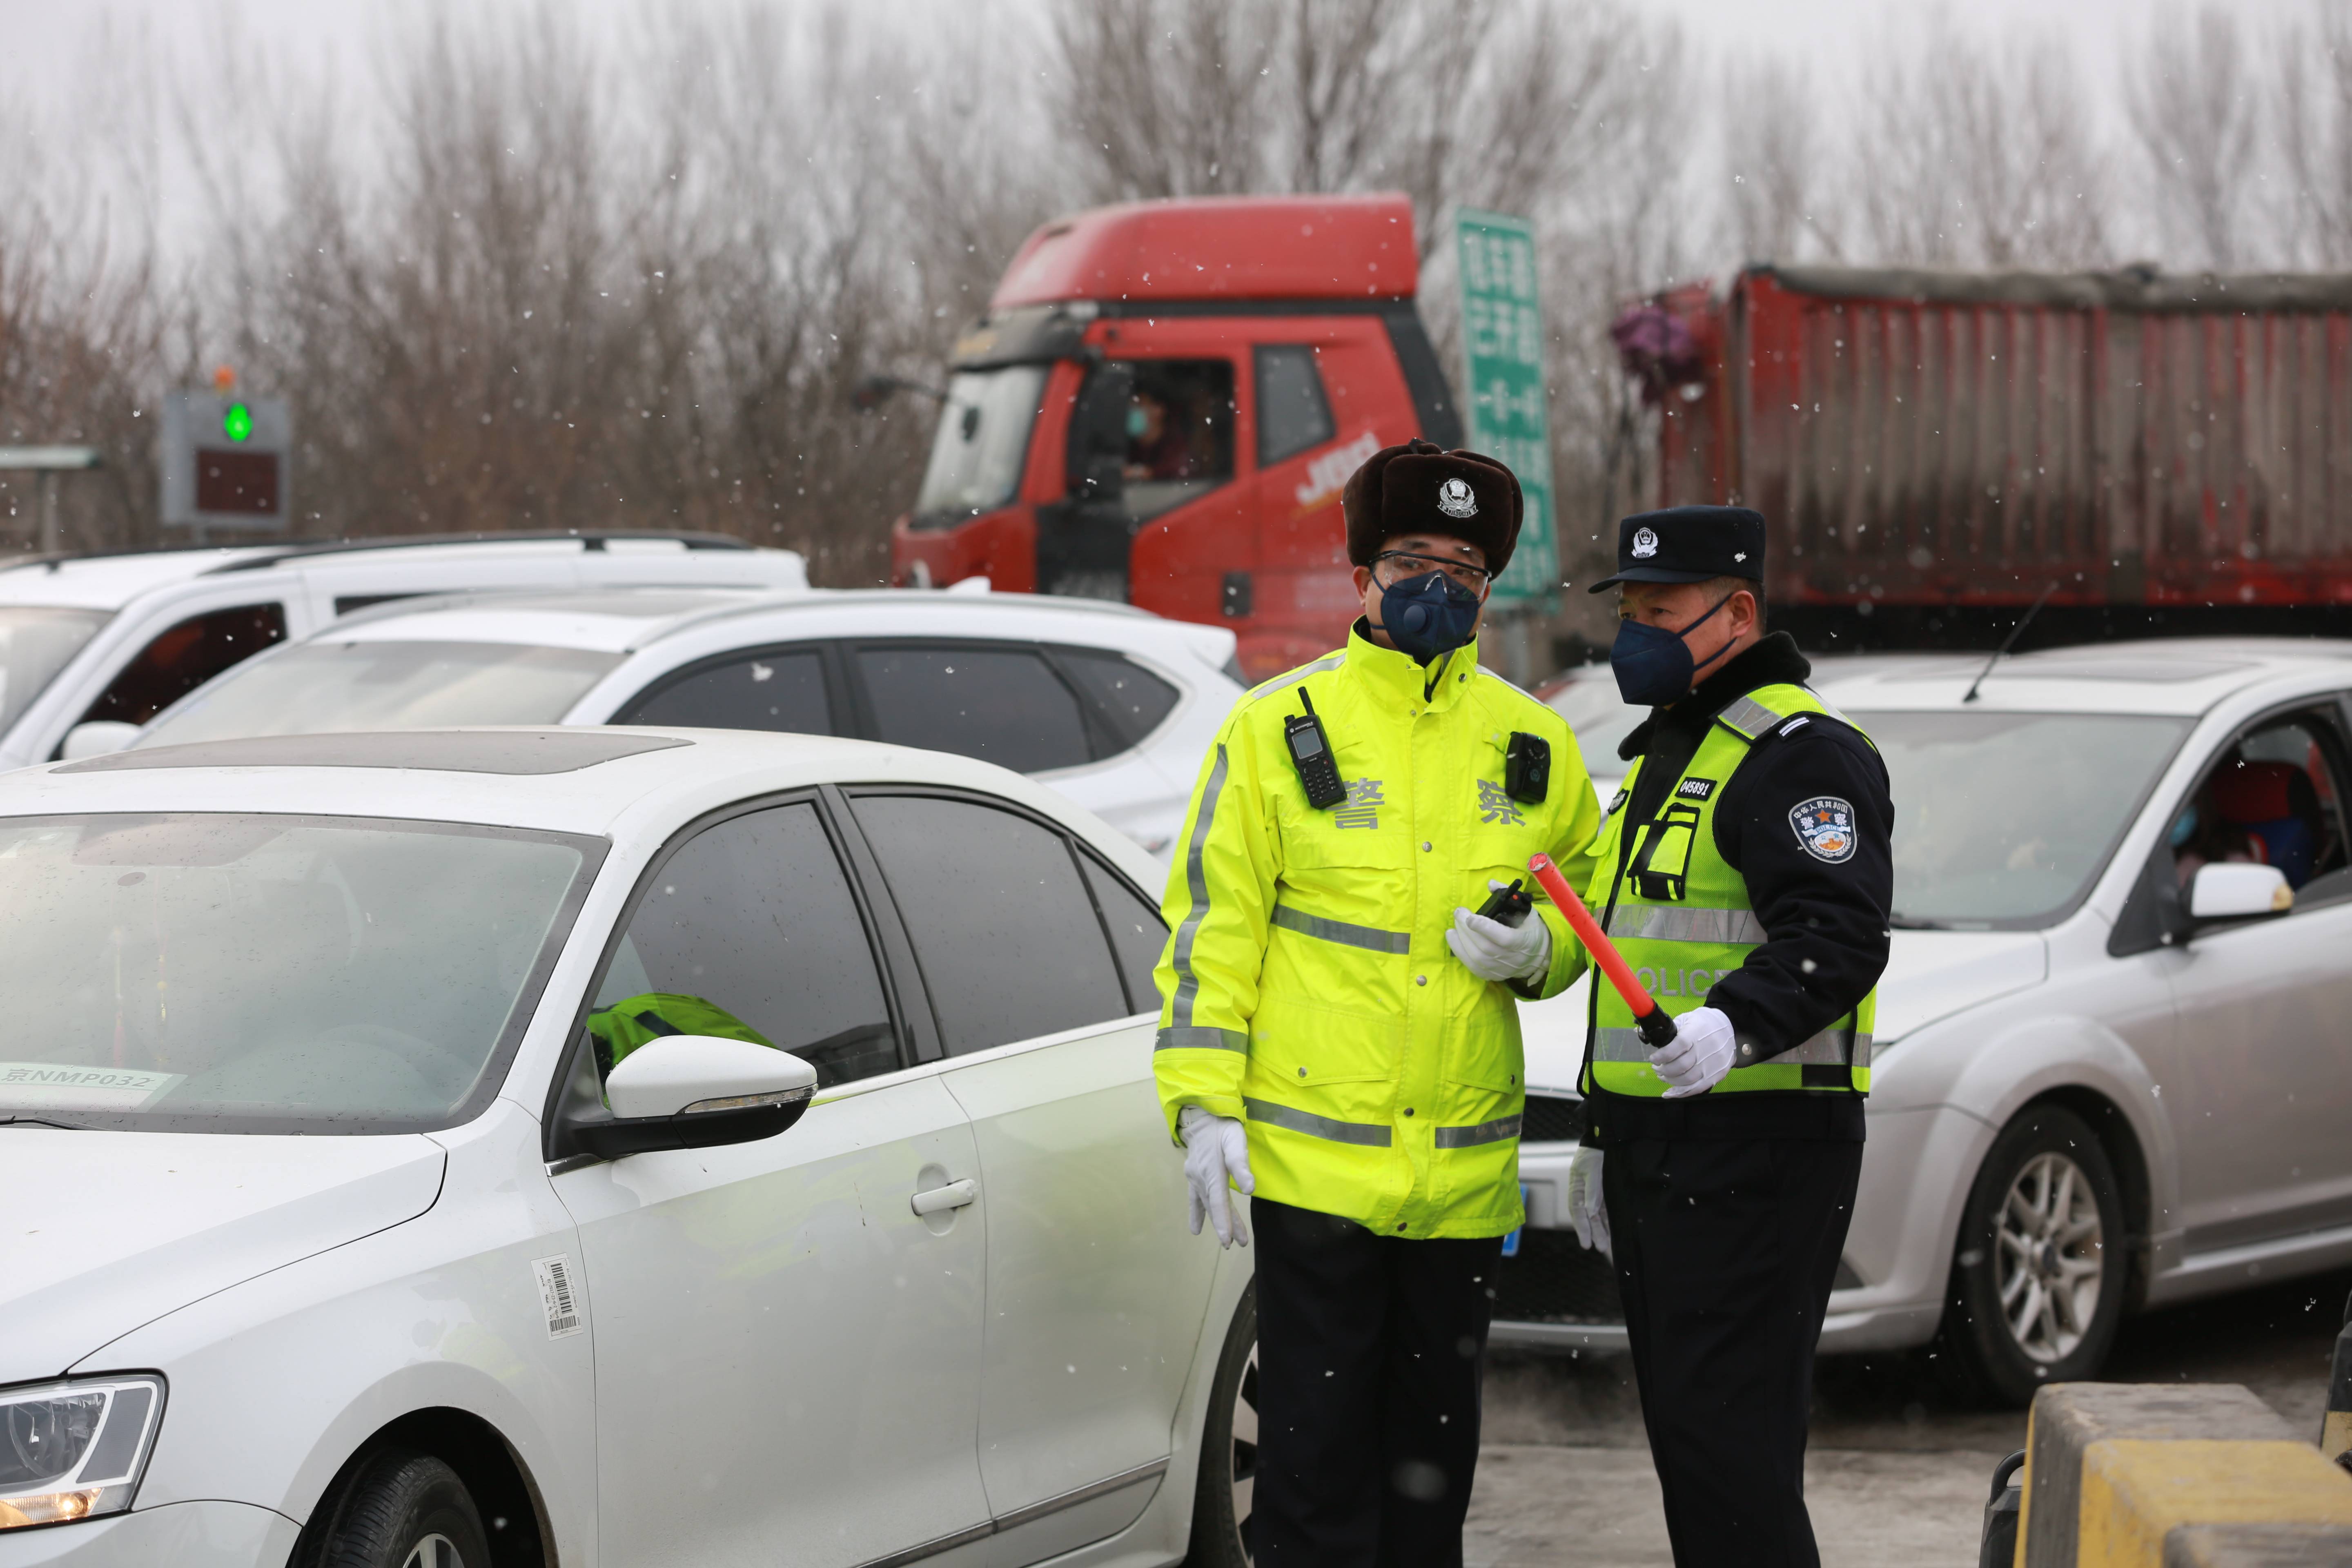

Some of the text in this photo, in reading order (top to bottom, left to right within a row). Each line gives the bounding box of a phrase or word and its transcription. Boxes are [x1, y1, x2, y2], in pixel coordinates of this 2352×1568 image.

[1679, 780, 1710, 796] 045891
[1326, 777, 1385, 830] 警
[1477, 779, 1526, 827] 察
[1793, 800, 1848, 819] 中华人民共和国
[1800, 813, 1847, 830] 警 察
[1, 1068, 154, 1087] 京NMP032
